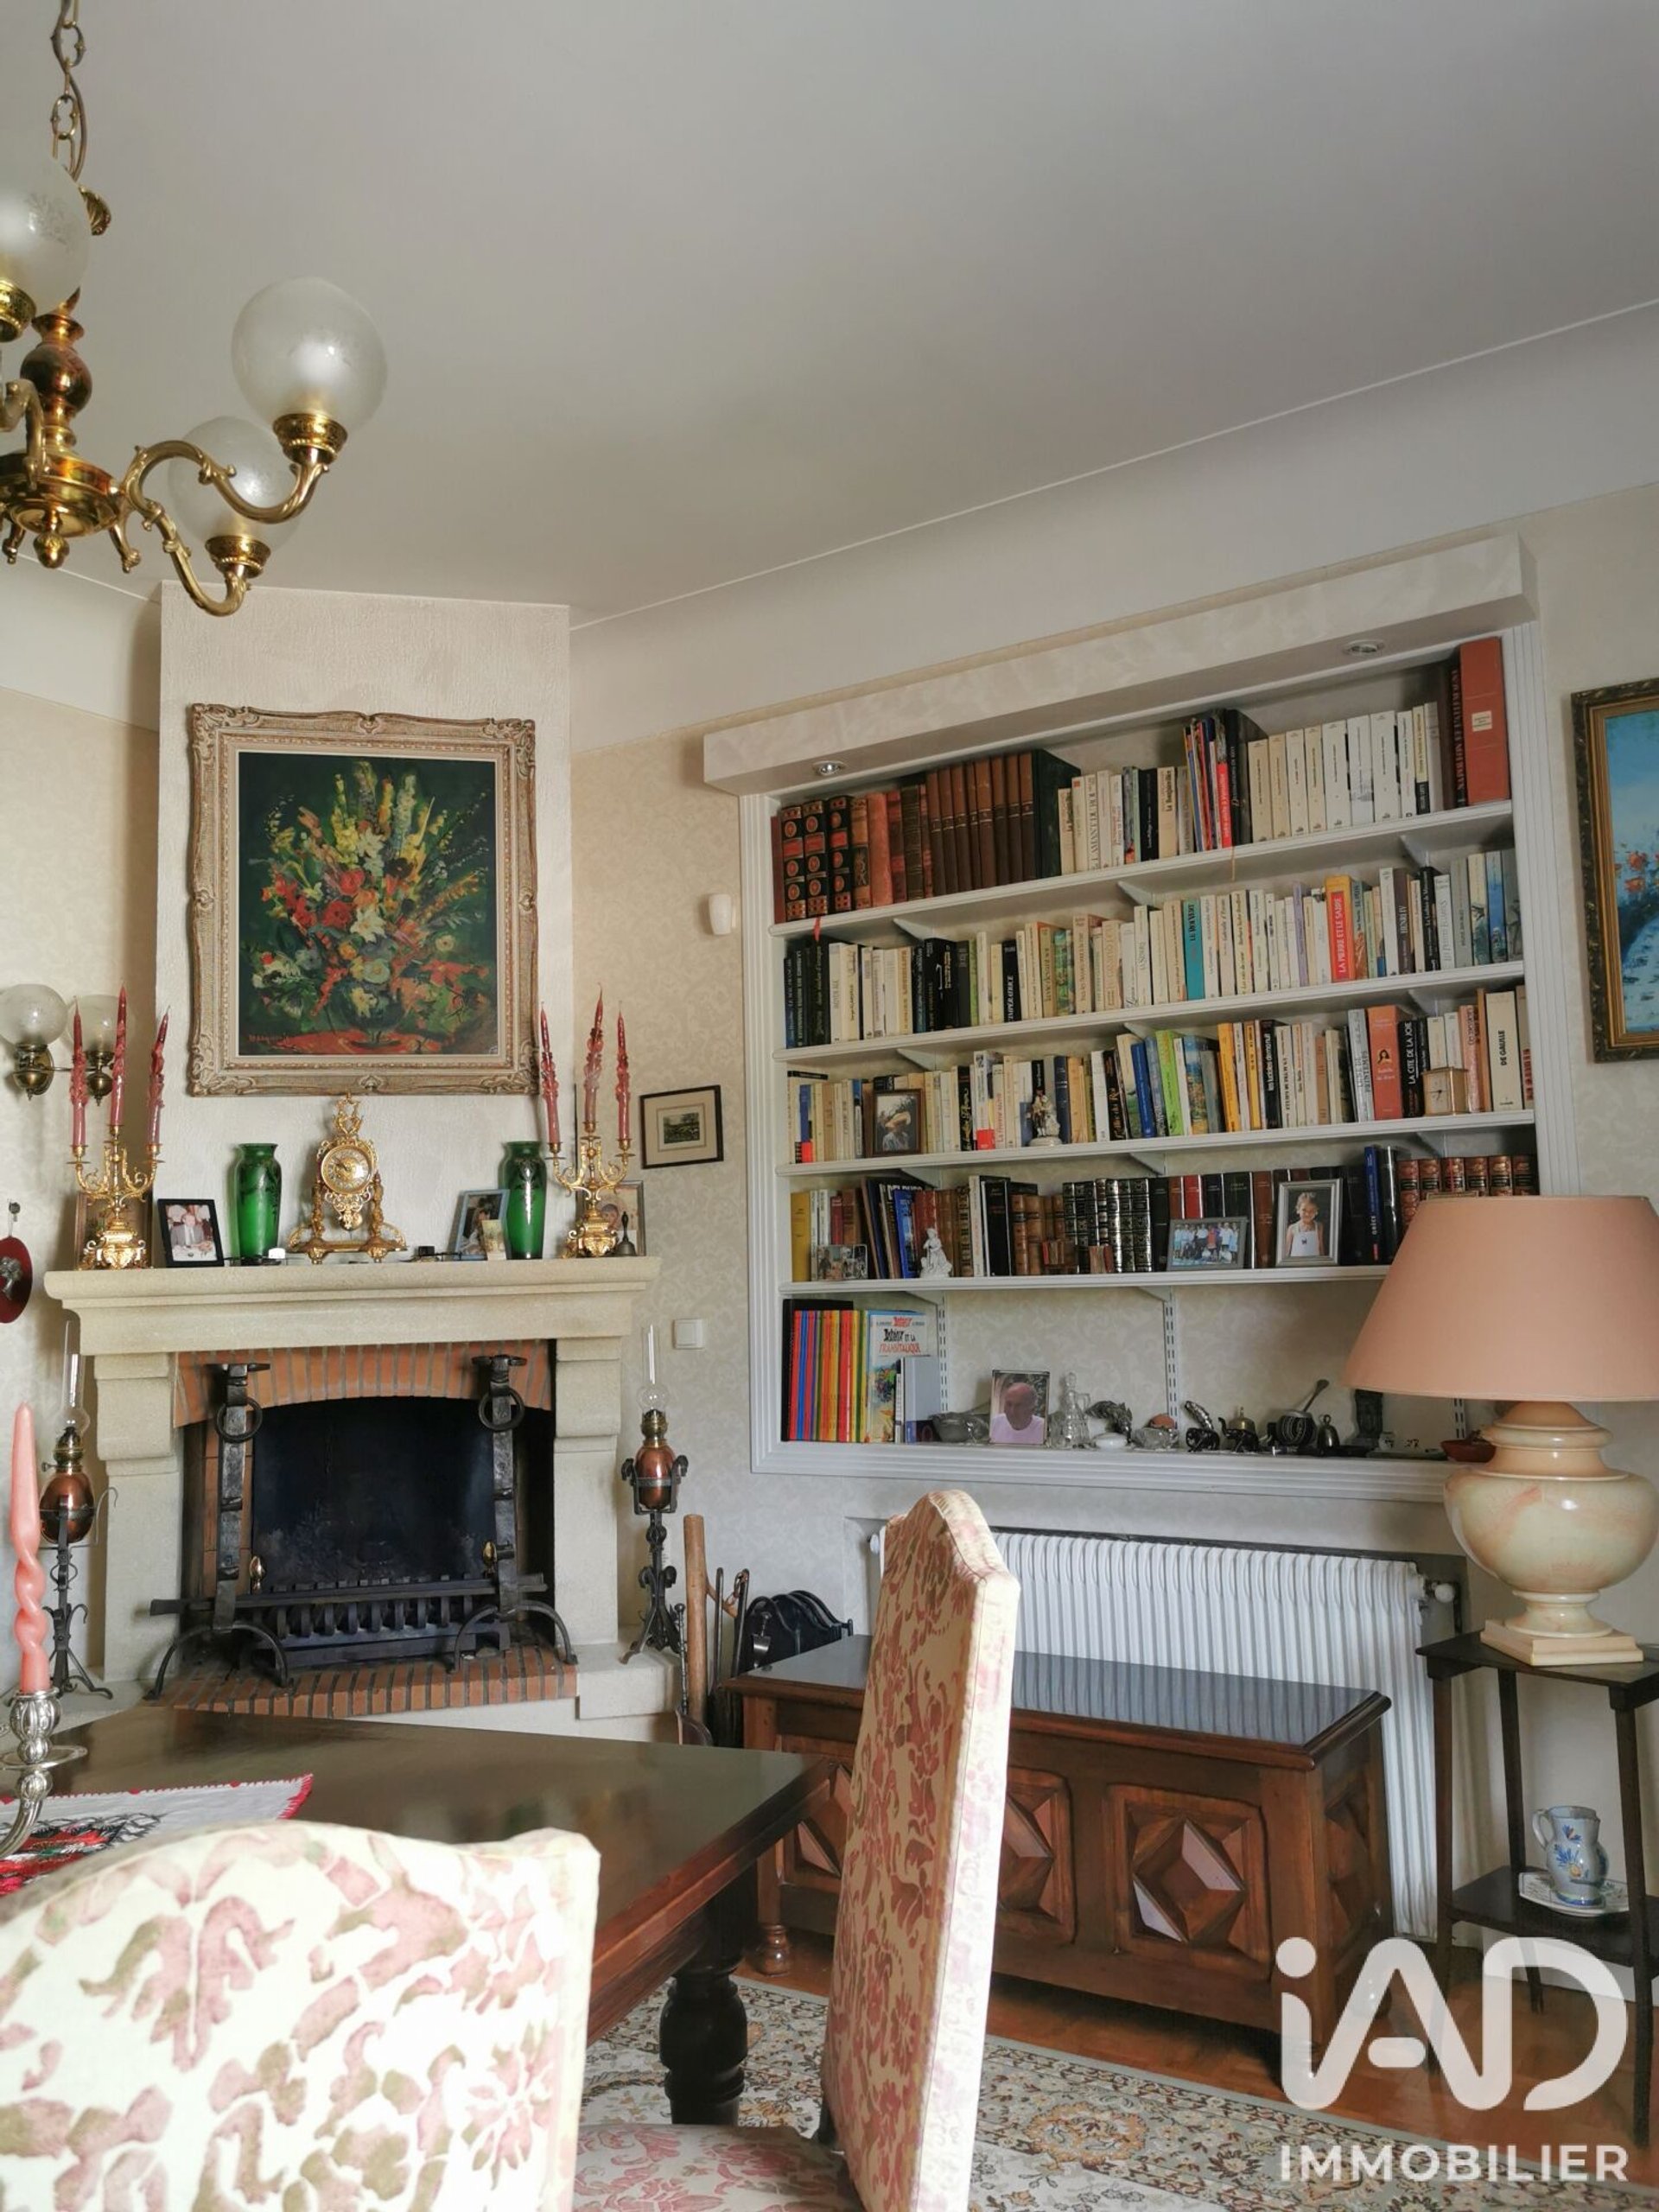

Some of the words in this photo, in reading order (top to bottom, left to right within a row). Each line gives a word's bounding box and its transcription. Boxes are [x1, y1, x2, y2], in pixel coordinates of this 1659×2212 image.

[1335, 920, 1343, 929] LE
[1336, 929, 1344, 938] ET
[1338, 963, 1346, 973] LA
[1404, 1021, 1413, 1037] JOIE
[1405, 1038, 1414, 1047] LA
[1406, 1049, 1414, 1058] DE
[1499, 1057, 1507, 1066] DE
[1408, 1075, 1416, 1084] LA
